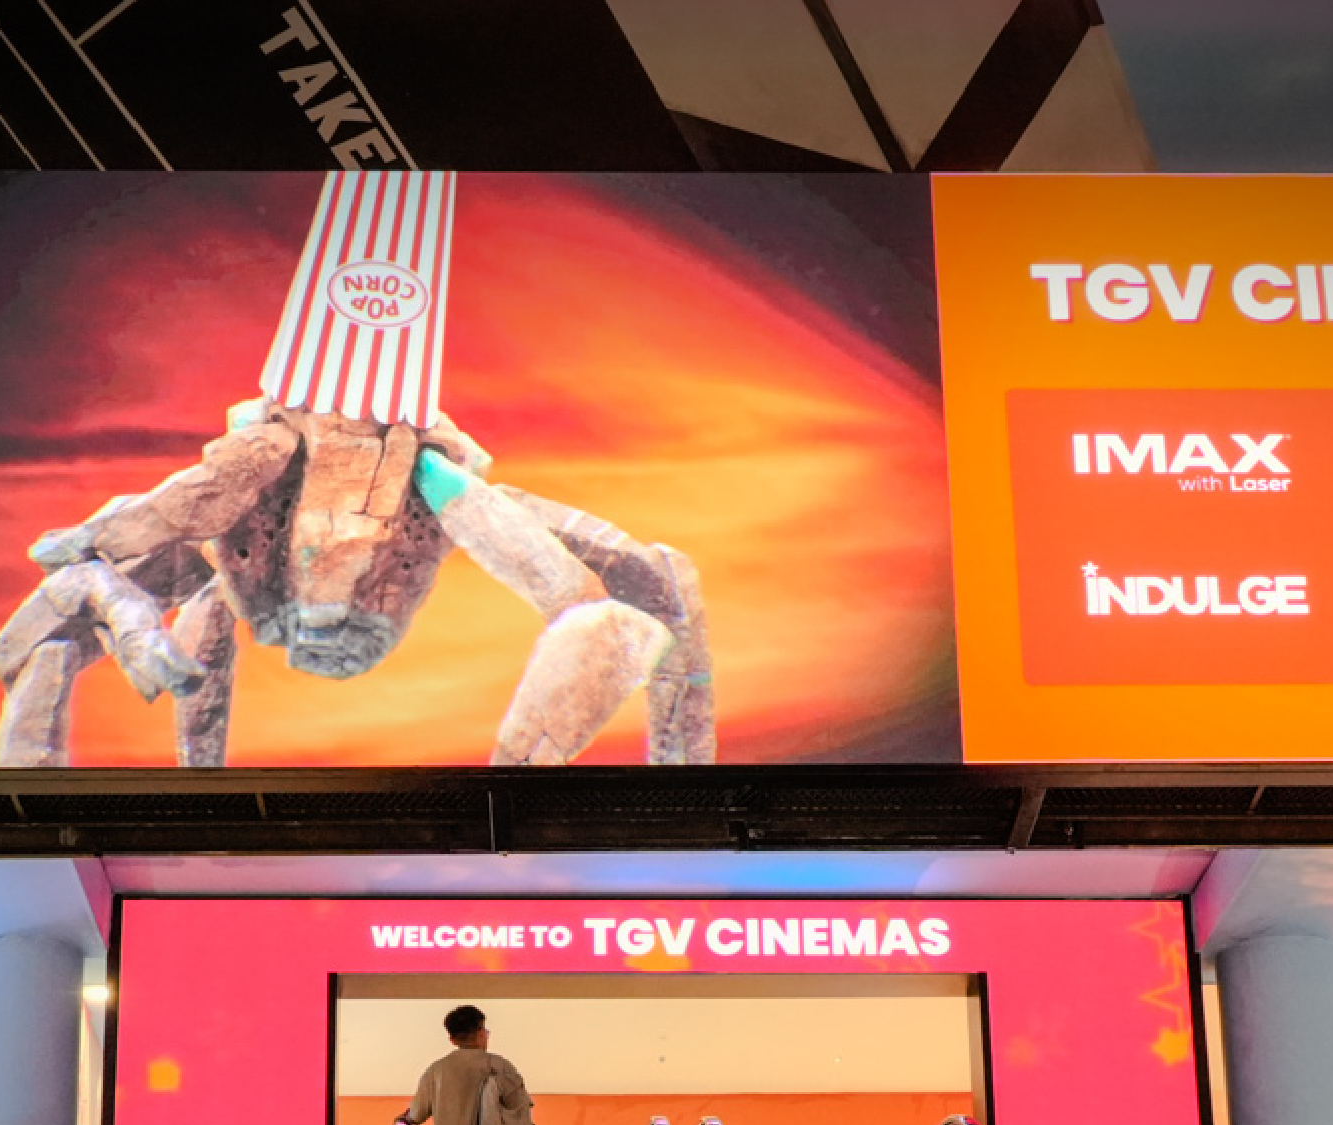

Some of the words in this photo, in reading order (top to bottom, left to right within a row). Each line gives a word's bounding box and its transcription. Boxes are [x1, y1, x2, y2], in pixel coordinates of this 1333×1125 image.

[259, 6, 397, 171] TAKE
[342, 274, 417, 299] CORN
[1030, 263, 1214, 323] TGV
[350, 294, 400, 320] POP
[1178, 475, 1223, 492] with
[1229, 475, 1292, 493] Laser
[371, 925, 524, 948] WELCOME
[531, 925, 573, 948] TO
[584, 919, 695, 956] TGV
[706, 918, 952, 956] CINEMAS
